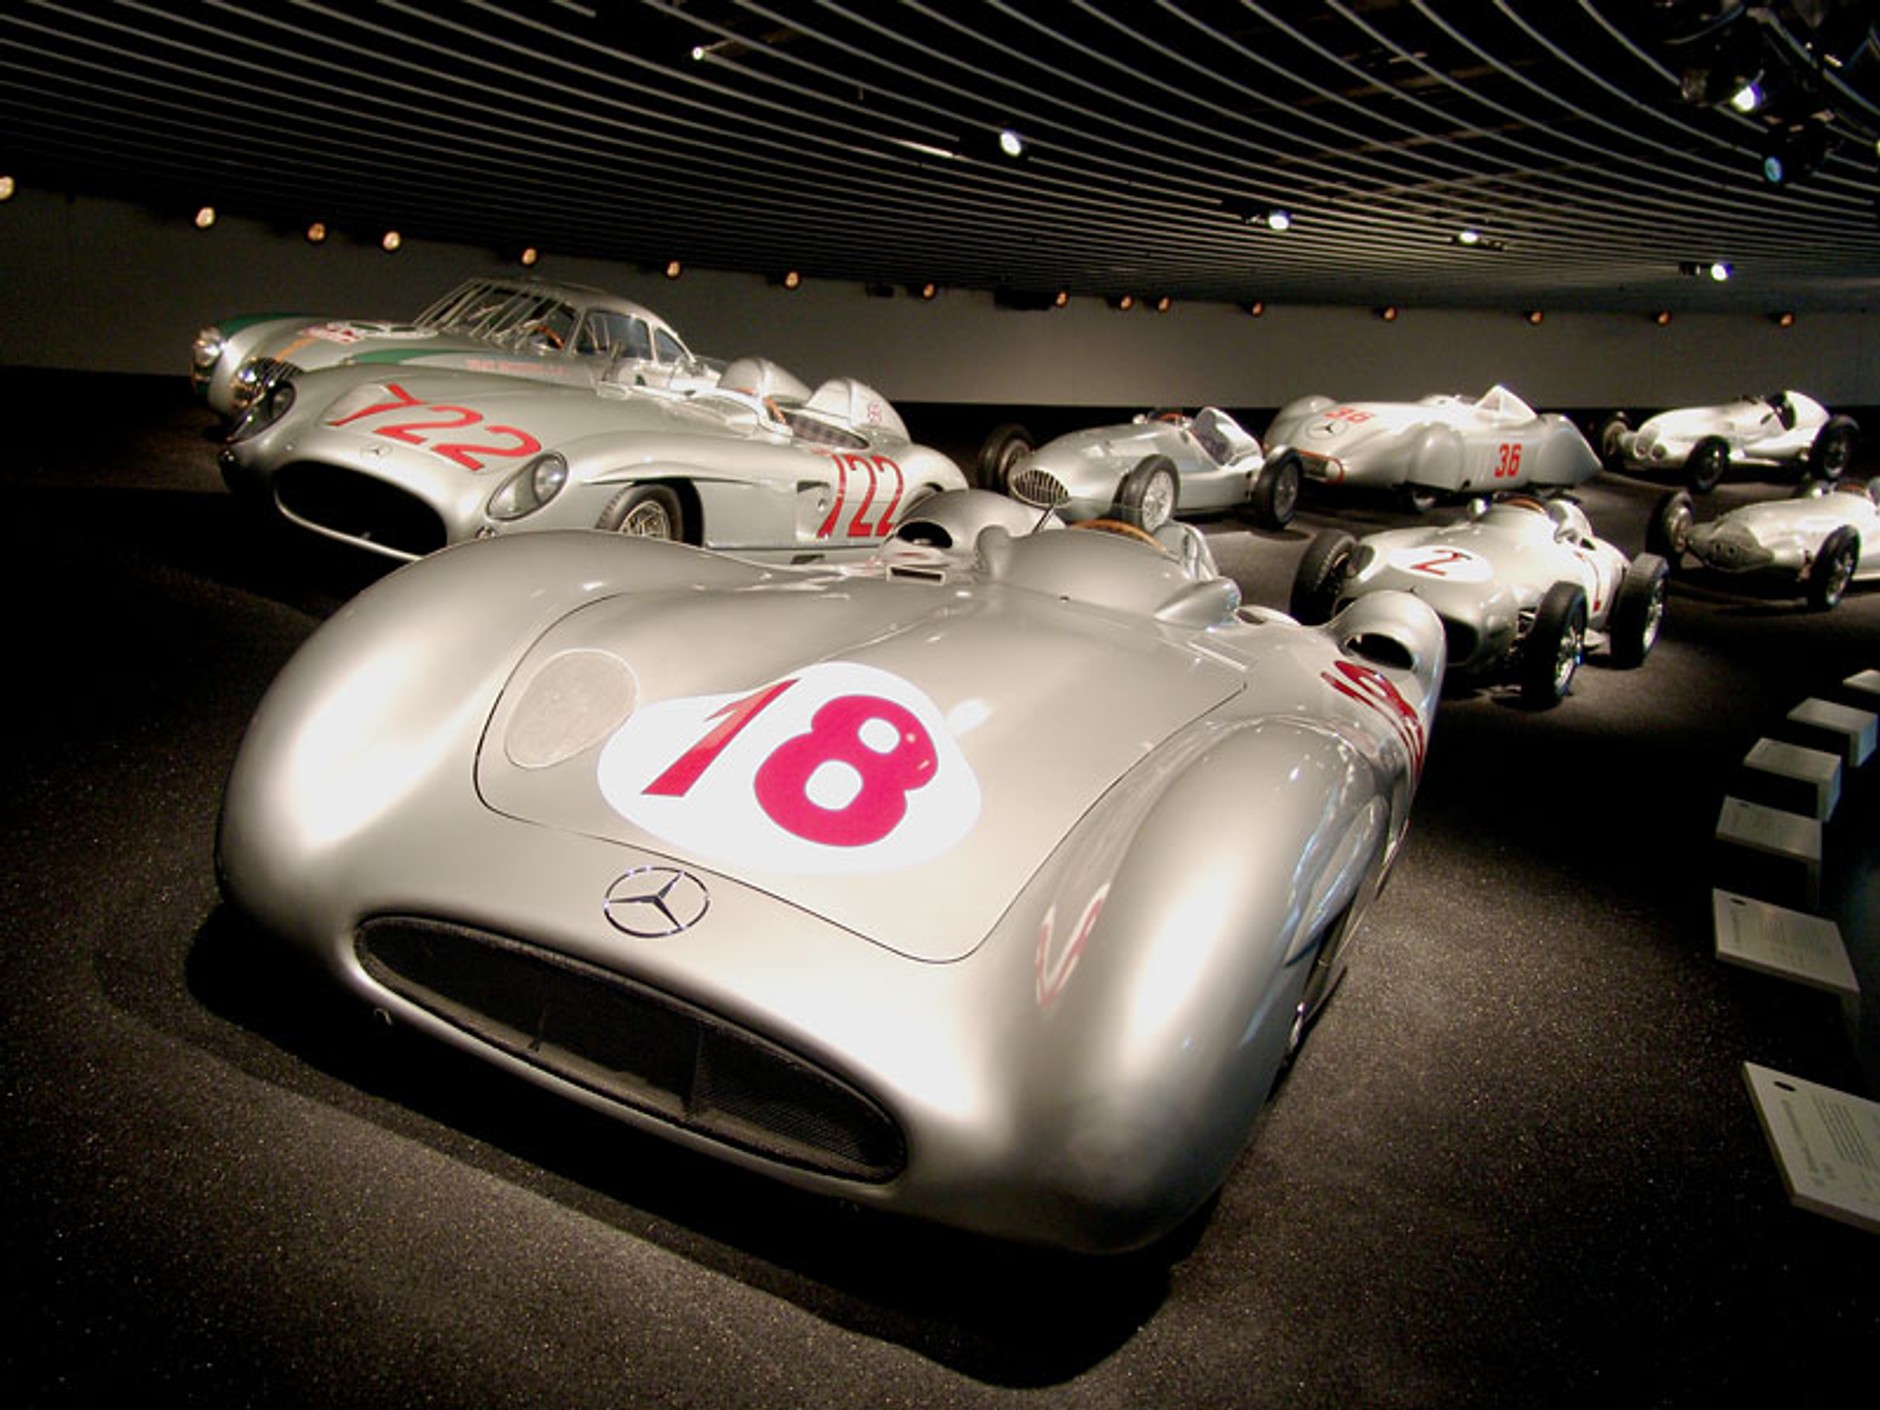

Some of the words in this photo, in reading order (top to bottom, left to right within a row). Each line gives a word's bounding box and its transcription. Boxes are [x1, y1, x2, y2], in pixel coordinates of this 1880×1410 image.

[323, 383, 542, 472] 722
[1325, 406, 1374, 424] 36
[1494, 443, 1521, 478] 36
[811, 447, 904, 538] 722
[1410, 549, 1472, 577] 2
[641, 677, 938, 847] 18
